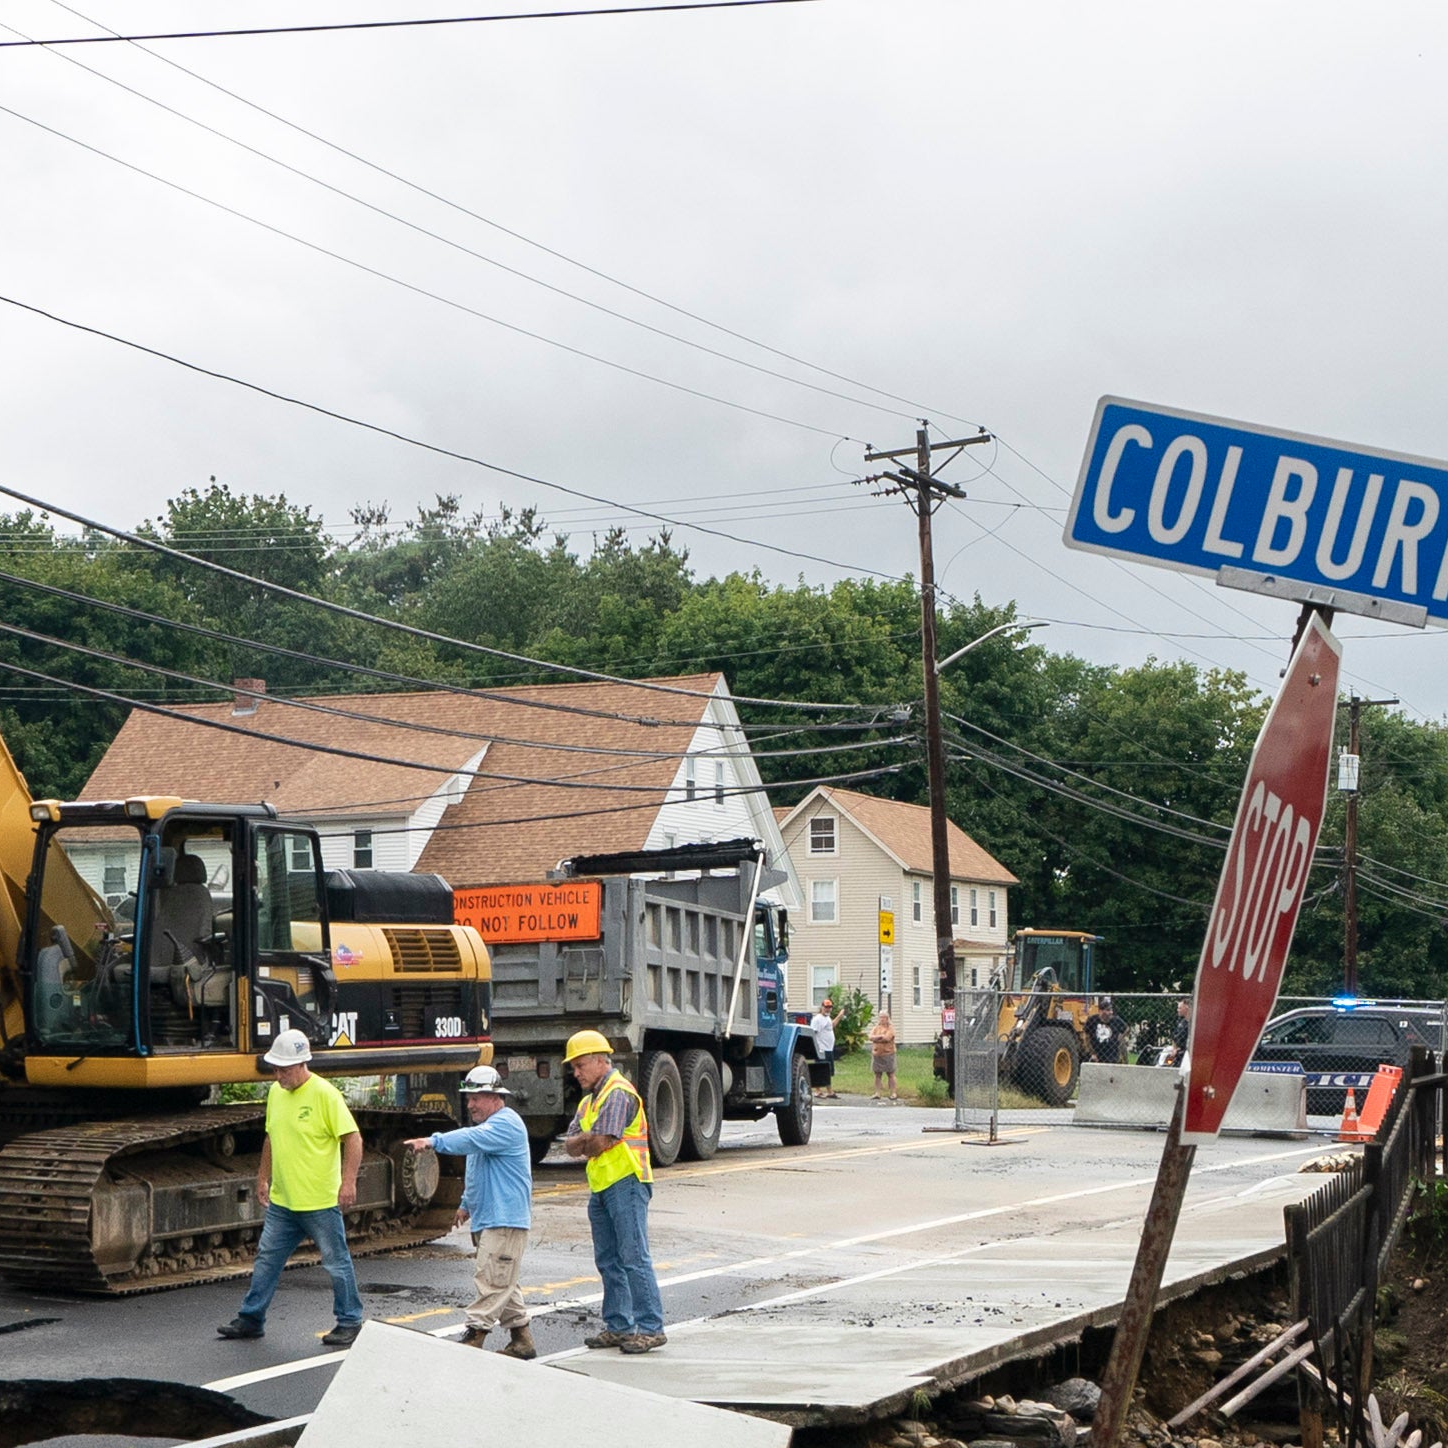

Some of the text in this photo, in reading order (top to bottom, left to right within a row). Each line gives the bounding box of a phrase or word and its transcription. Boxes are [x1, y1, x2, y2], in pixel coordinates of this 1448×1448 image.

[1211, 780, 1311, 983] STOP
[453, 890, 591, 911] ONSTRUCTION VEHICLE
[481, 915, 510, 933] NOT
[518, 913, 579, 932] FOLLOW
[435, 1017, 462, 1038] 330D
